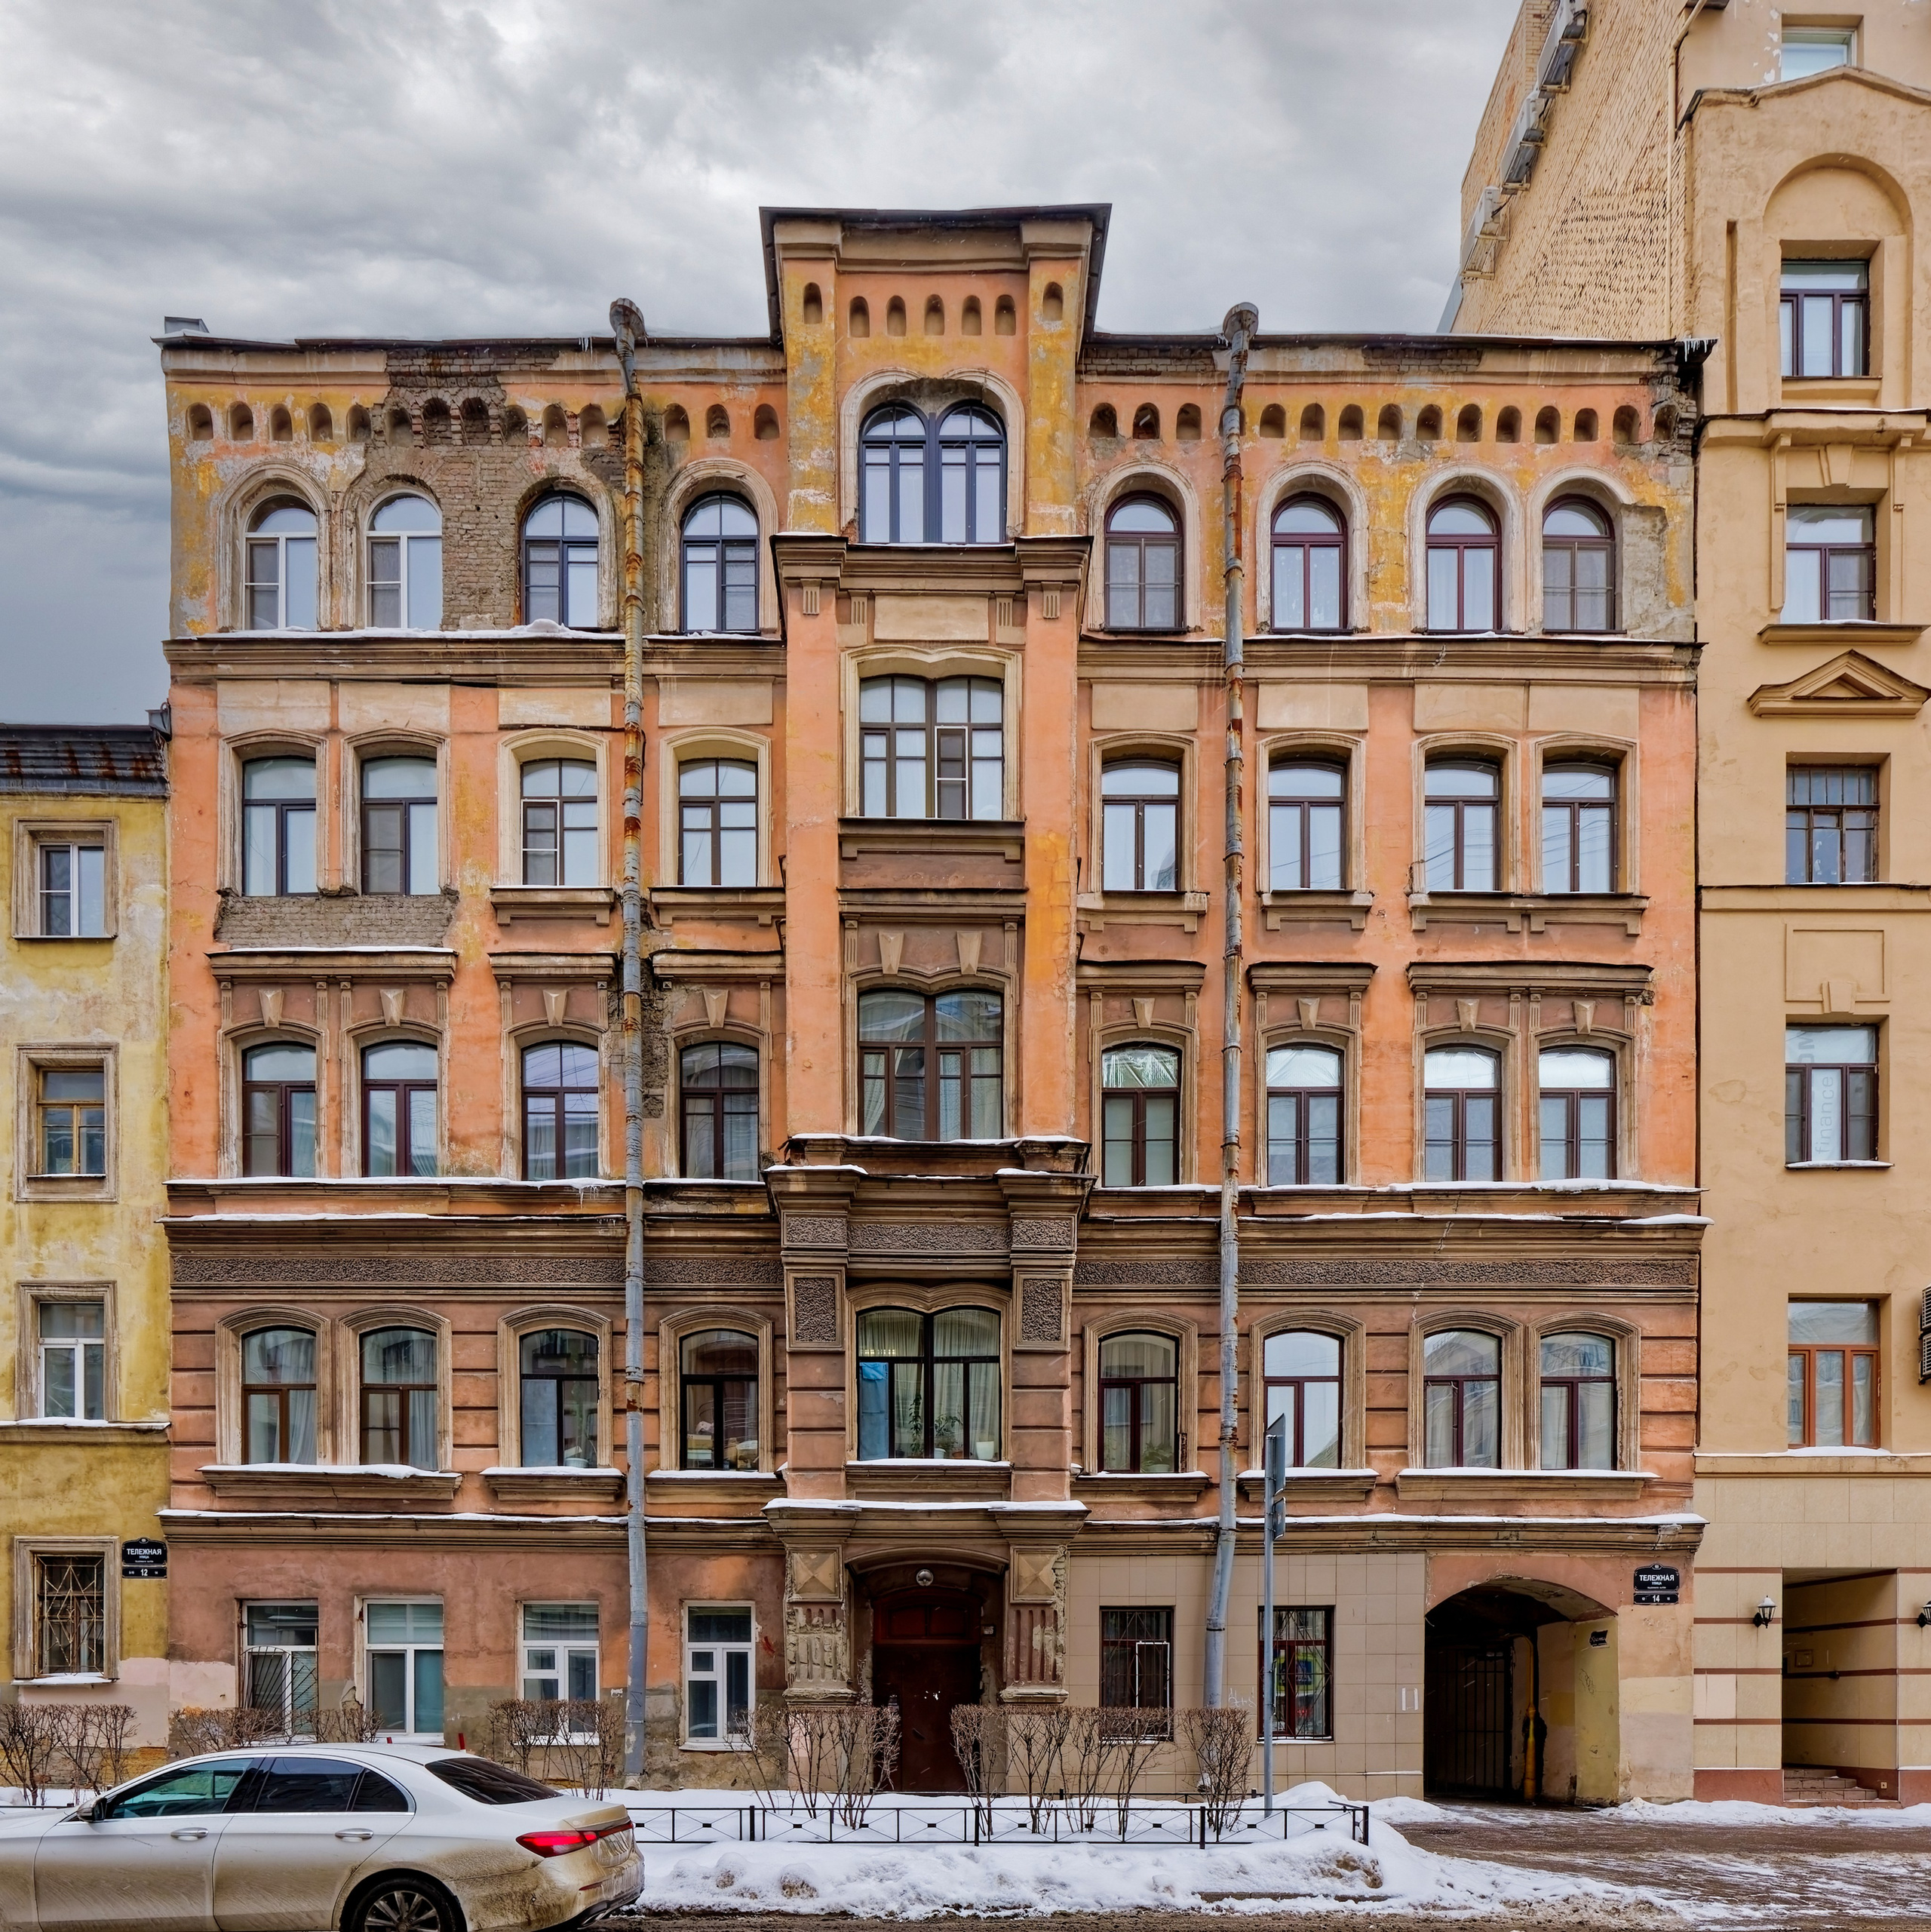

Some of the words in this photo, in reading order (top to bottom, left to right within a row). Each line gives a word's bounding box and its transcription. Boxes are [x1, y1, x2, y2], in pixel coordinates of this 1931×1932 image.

[1815, 1076, 1834, 1154] finance
[140, 1568, 148, 1577] 12
[1652, 1594, 1660, 1602] 14
